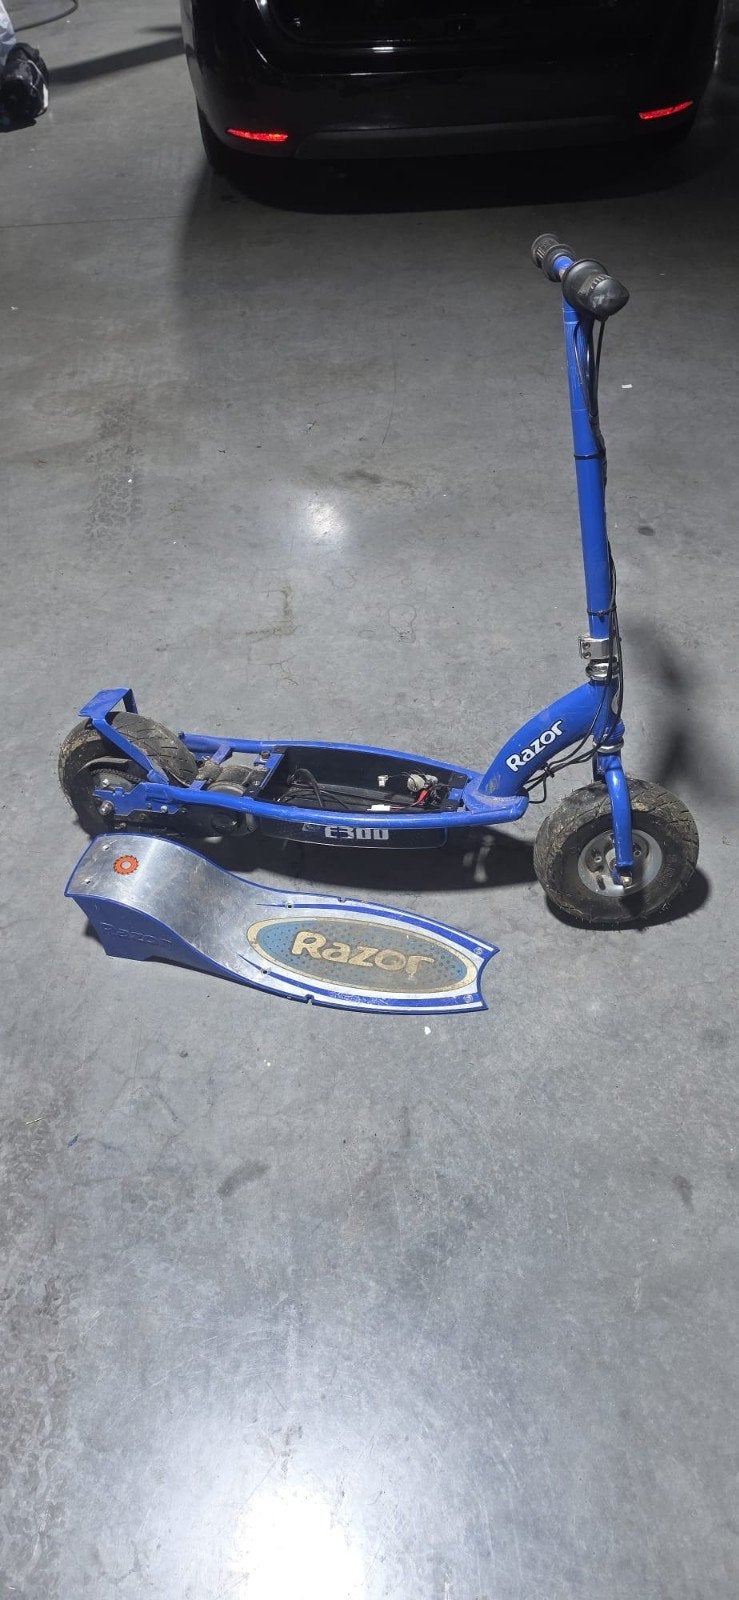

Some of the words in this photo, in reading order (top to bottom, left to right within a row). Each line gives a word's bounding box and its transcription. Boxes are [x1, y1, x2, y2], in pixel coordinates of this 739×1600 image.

[505, 720, 563, 772] Razor
[325, 825, 389, 840] E300
[291, 931, 435, 974] Razor
